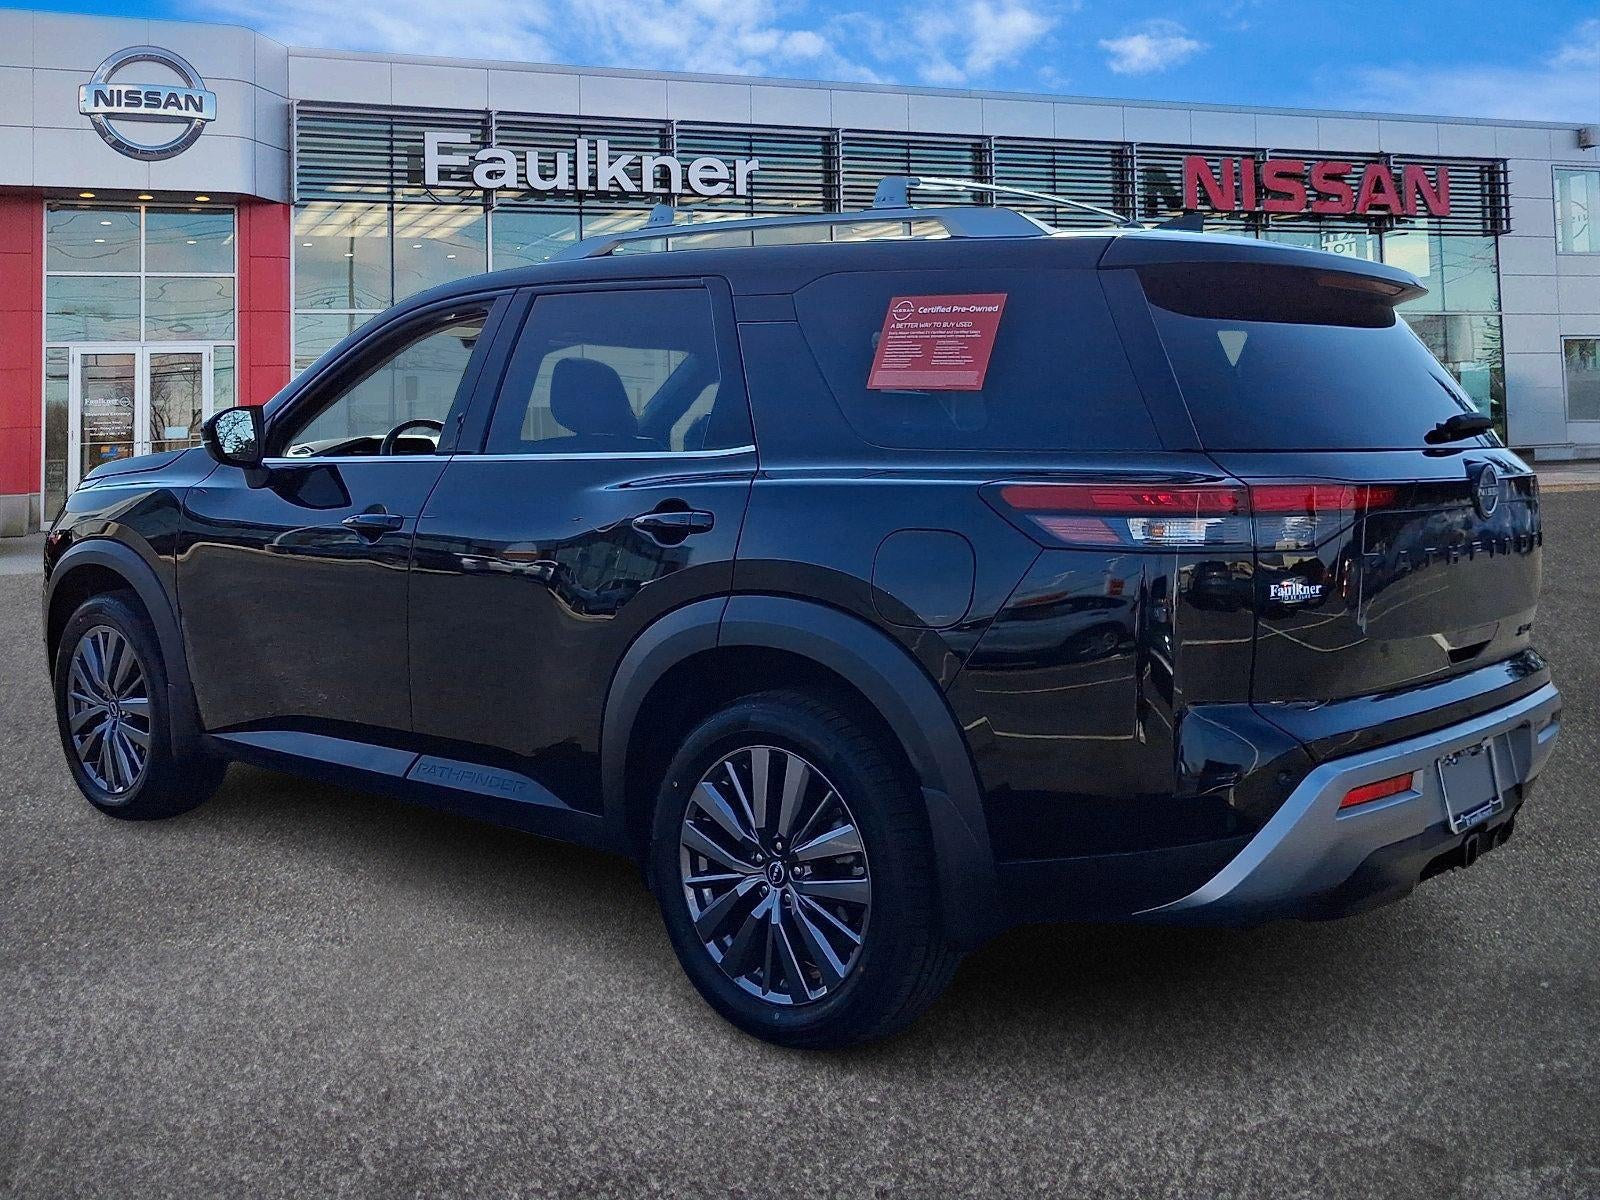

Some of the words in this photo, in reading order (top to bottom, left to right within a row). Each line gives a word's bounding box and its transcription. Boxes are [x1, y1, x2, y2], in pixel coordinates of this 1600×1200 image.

[94, 89, 203, 113] NISSAN
[424, 131, 760, 196] Faulkner
[1182, 155, 1450, 216] NISSAN
[918, 305, 951, 314] Certified
[952, 304, 999, 313] Pre-Owned
[1269, 583, 1322, 598] Faulkner
[416, 762, 528, 792] PATHFINDER
